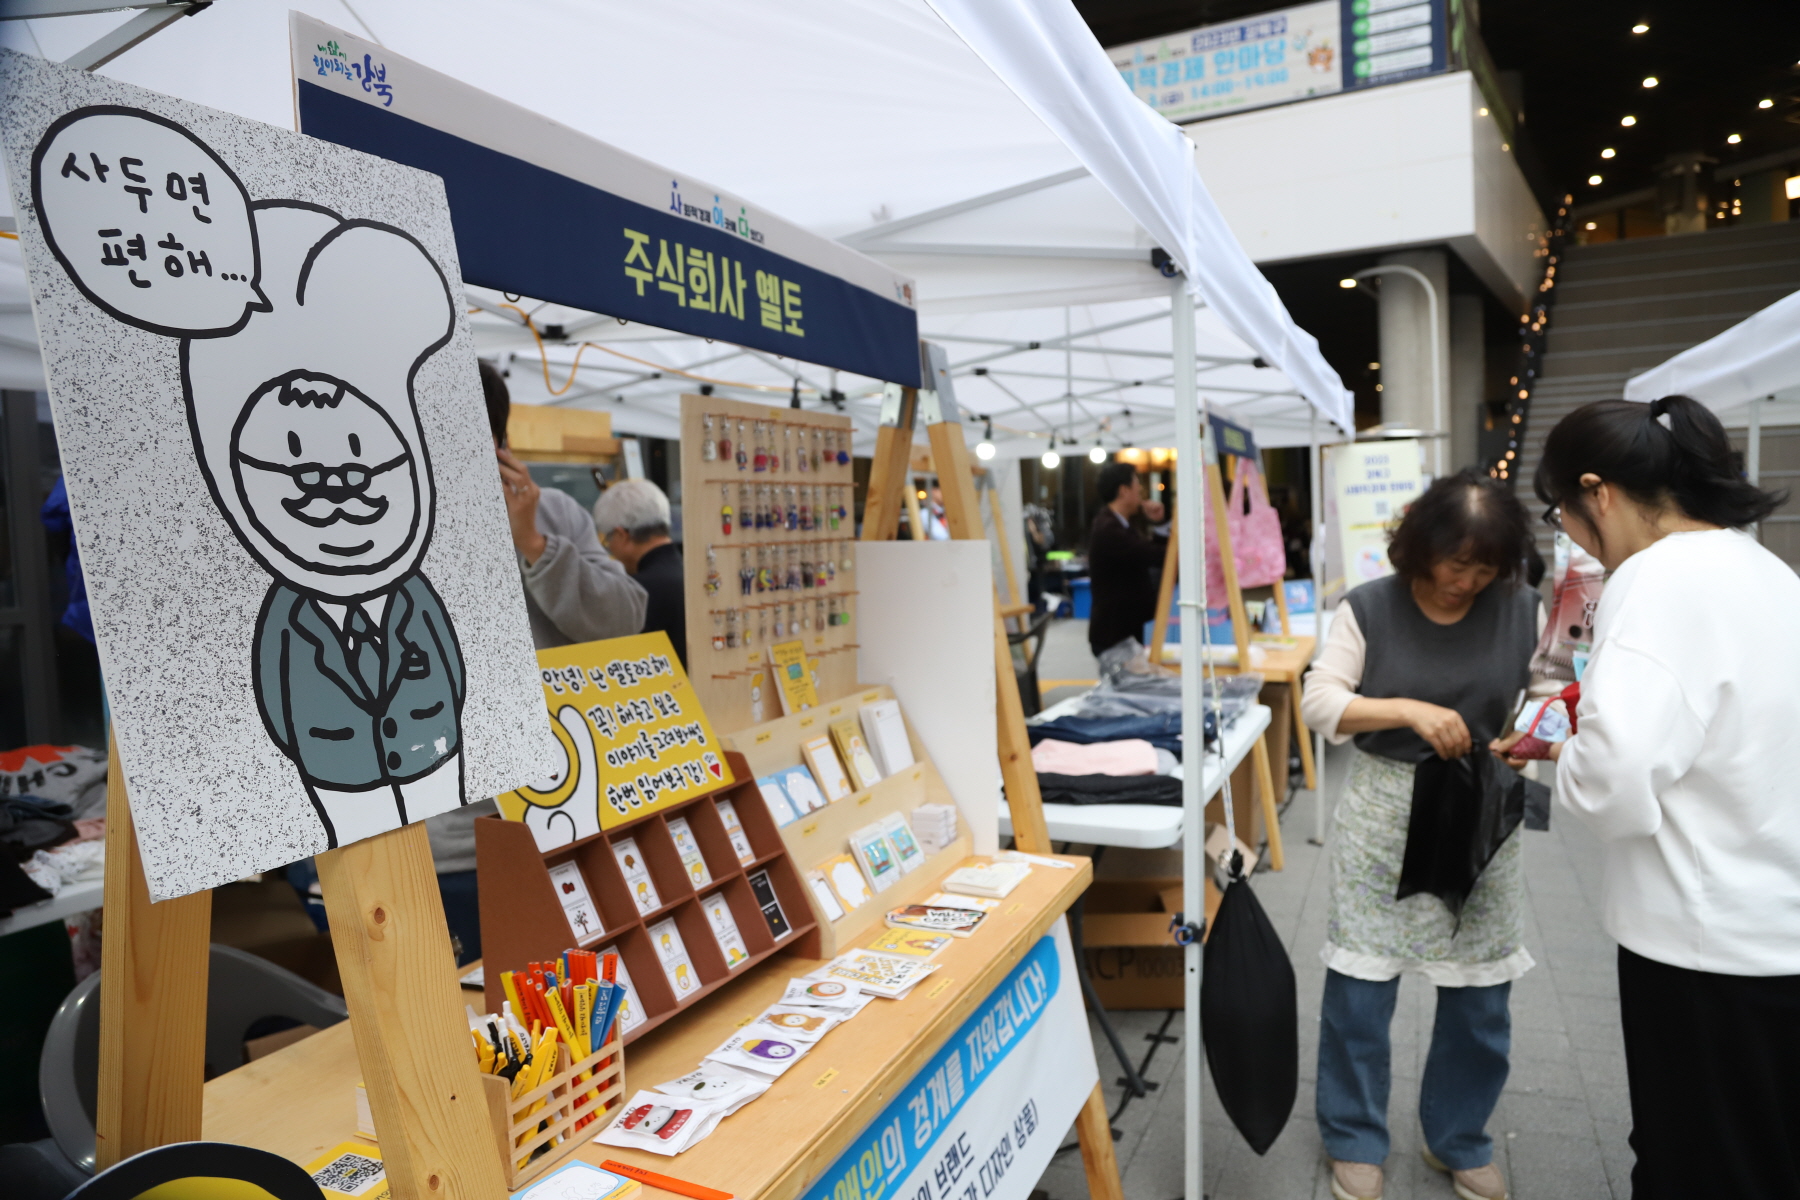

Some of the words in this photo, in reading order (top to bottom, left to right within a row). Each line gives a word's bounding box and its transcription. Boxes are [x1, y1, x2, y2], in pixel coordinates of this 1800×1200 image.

[351, 53, 393, 107] 강북
[61, 152, 213, 224] 사두면
[624, 228, 747, 321] 주식회사
[755, 269, 805, 337] 옐토
[541, 667, 586, 692] 안녕!
[588, 668, 608, 689] 난
[588, 707, 618, 738] 꼭!
[607, 786, 640, 813] 한번
[821, 1116, 907, 1200] 애인의
[908, 1049, 966, 1150] 경계를
[979, 1132, 1014, 1199] 디자인
[1014, 1098, 1039, 1150] 상품)
[934, 1131, 975, 1200] 브랜드
